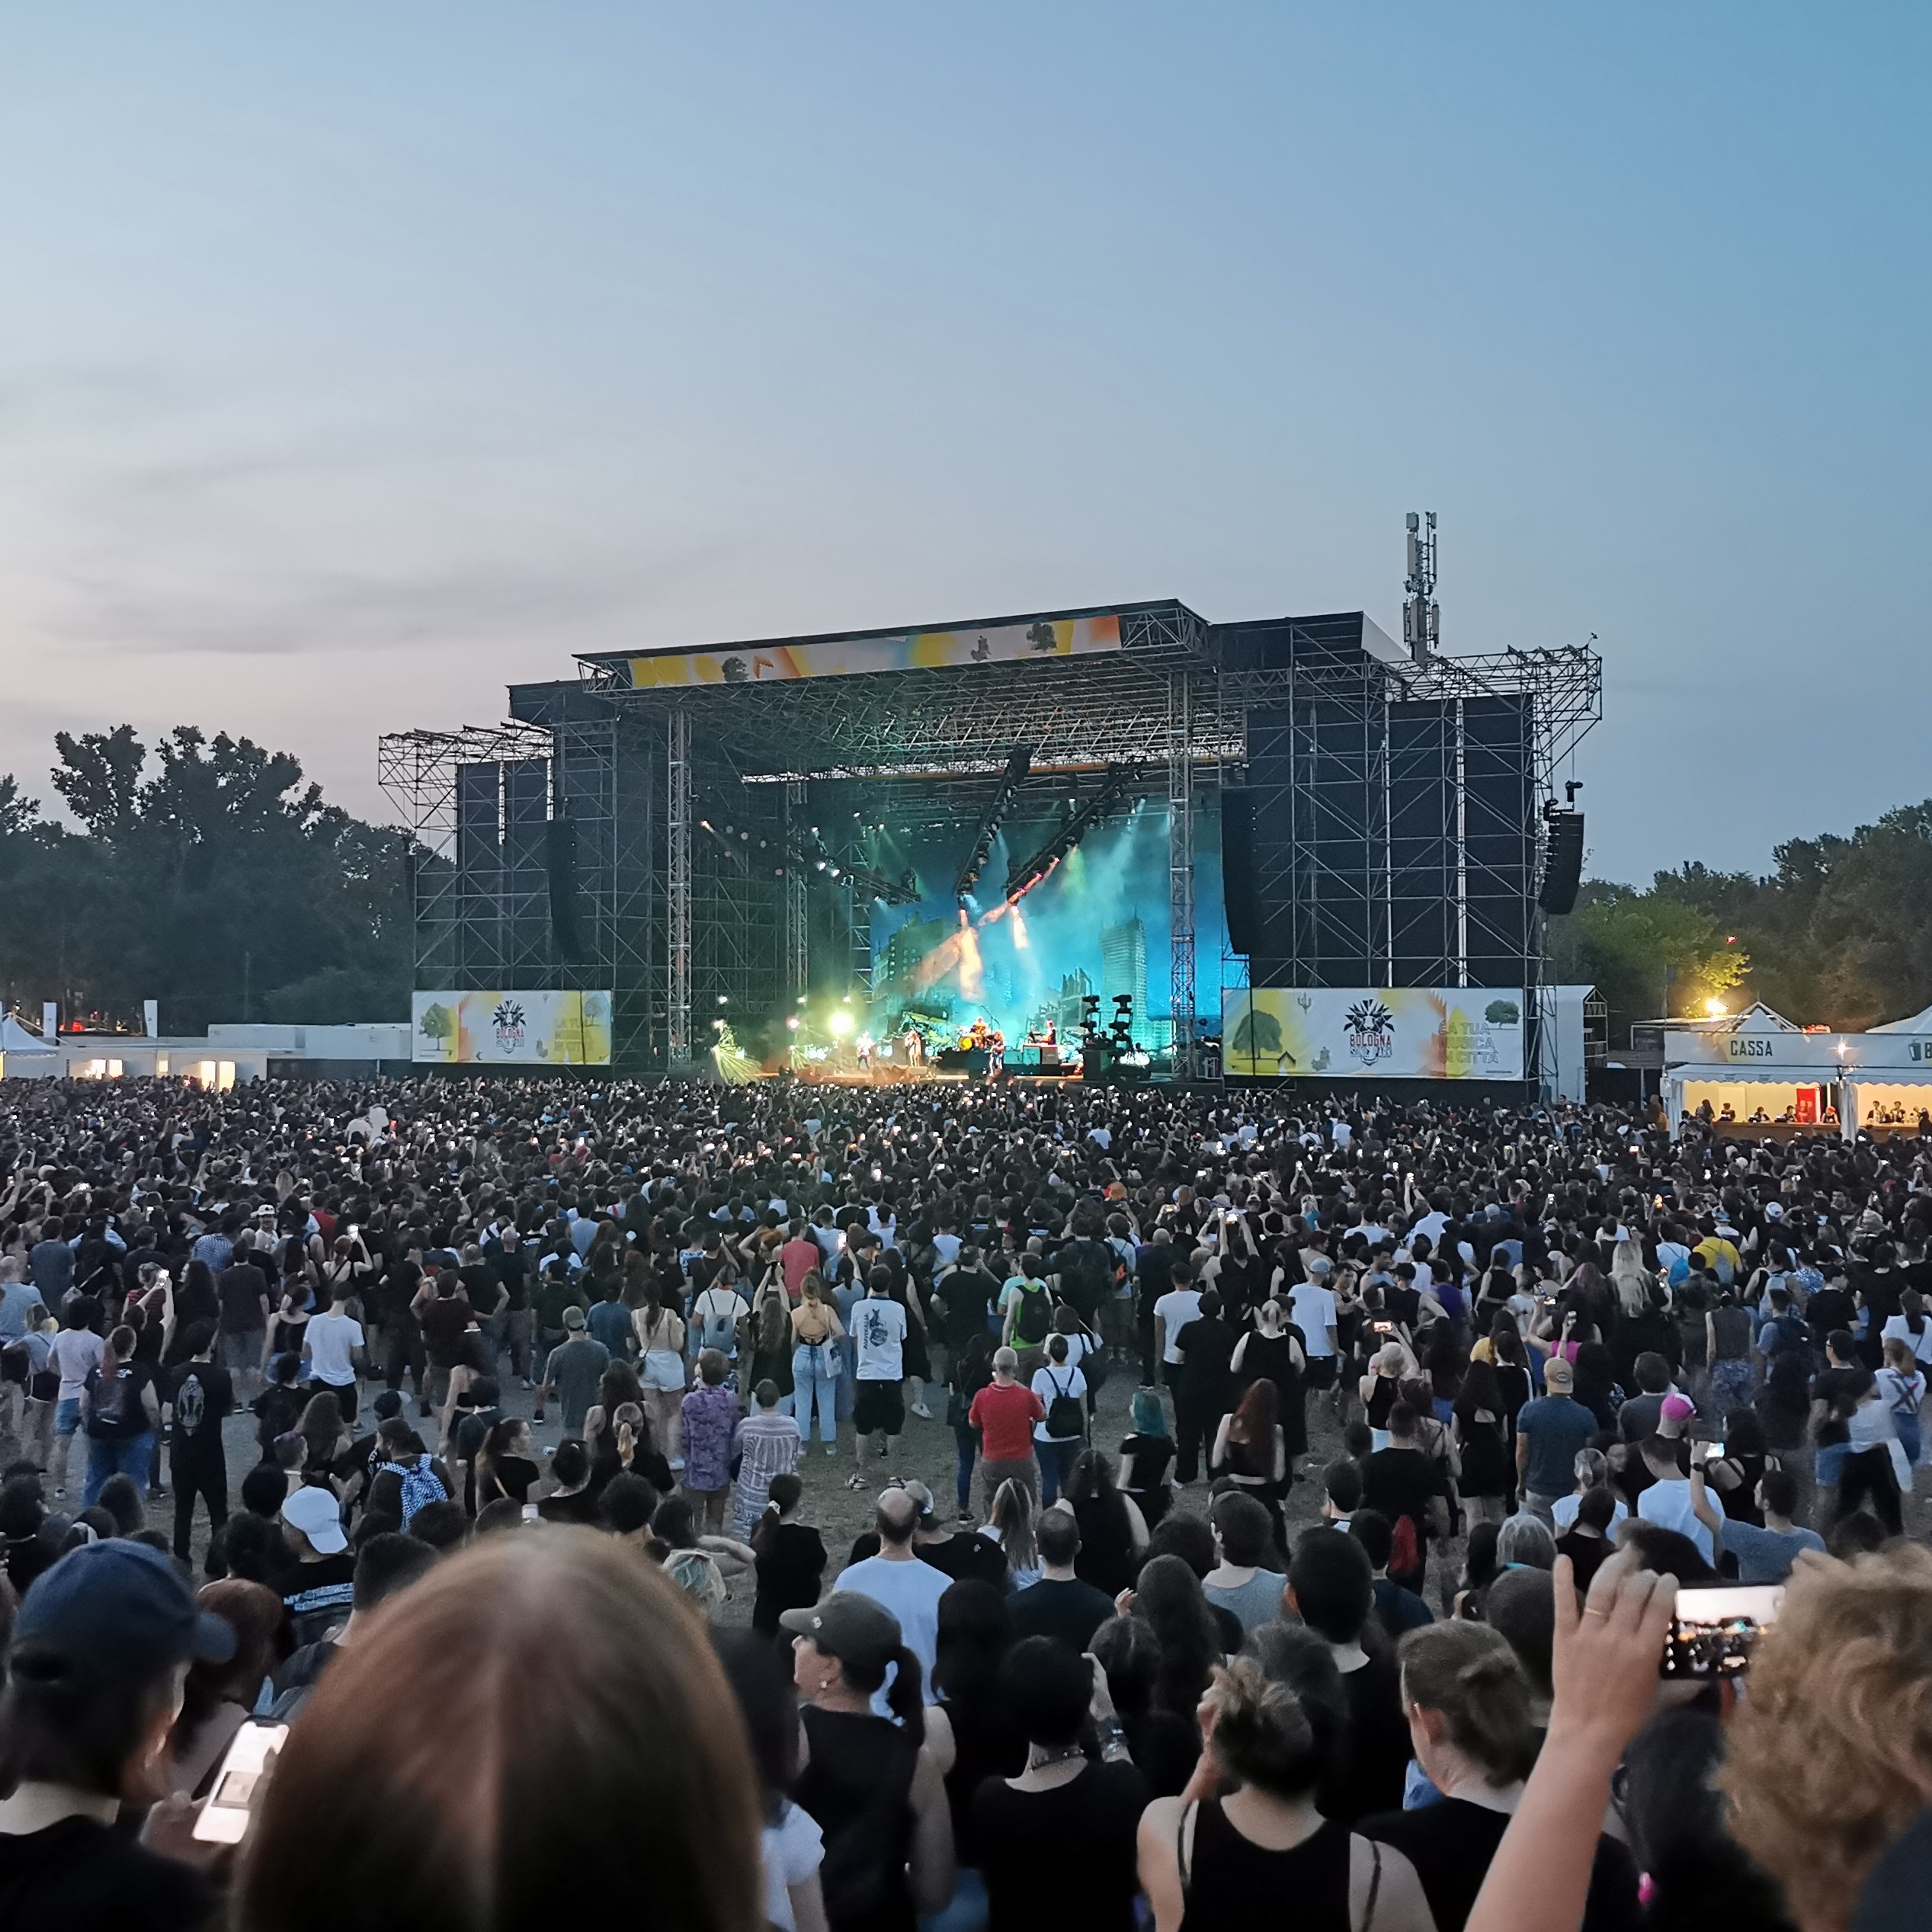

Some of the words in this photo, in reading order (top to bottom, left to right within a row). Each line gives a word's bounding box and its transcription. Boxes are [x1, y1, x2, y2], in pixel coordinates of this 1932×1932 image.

[1460, 1022, 1491, 1035] TUA
[1350, 1034, 1392, 1046] BOLOGNA
[1730, 1040, 1773, 1056] CASSA
